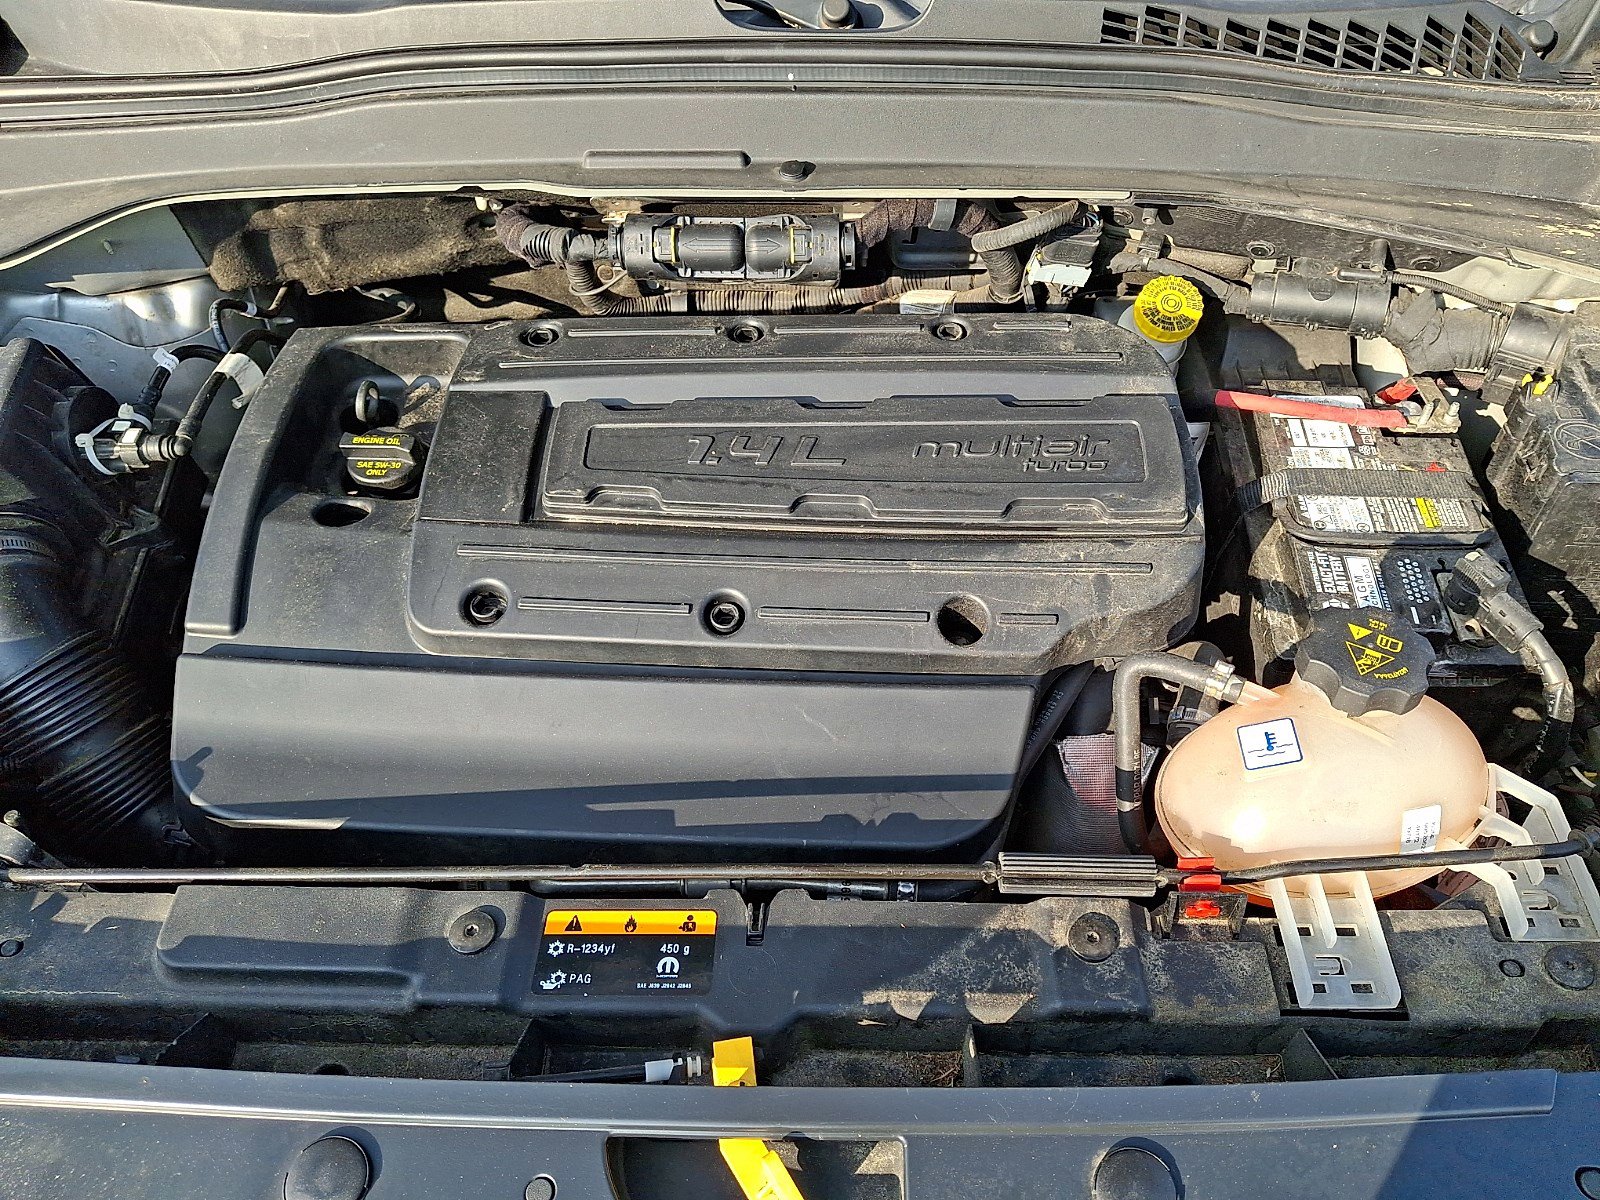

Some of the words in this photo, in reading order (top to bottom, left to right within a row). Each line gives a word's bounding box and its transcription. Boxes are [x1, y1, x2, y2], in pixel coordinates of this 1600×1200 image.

[352, 436, 385, 445] ENGINE
[385, 437, 401, 445] OIL
[911, 433, 1111, 458] multiair
[356, 461, 373, 469] SAE
[374, 461, 402, 469] 5W-30
[1022, 457, 1110, 472] turbo
[1314, 551, 1337, 594] EXACT-FIT
[1328, 555, 1351, 593] BATTERY
[1362, 563, 1379, 606] CHNOLOGY
[566, 943, 617, 956] R-1234yf
[659, 943, 680, 954] 450
[683, 945, 691, 956] g
[569, 974, 592, 984] PAG
